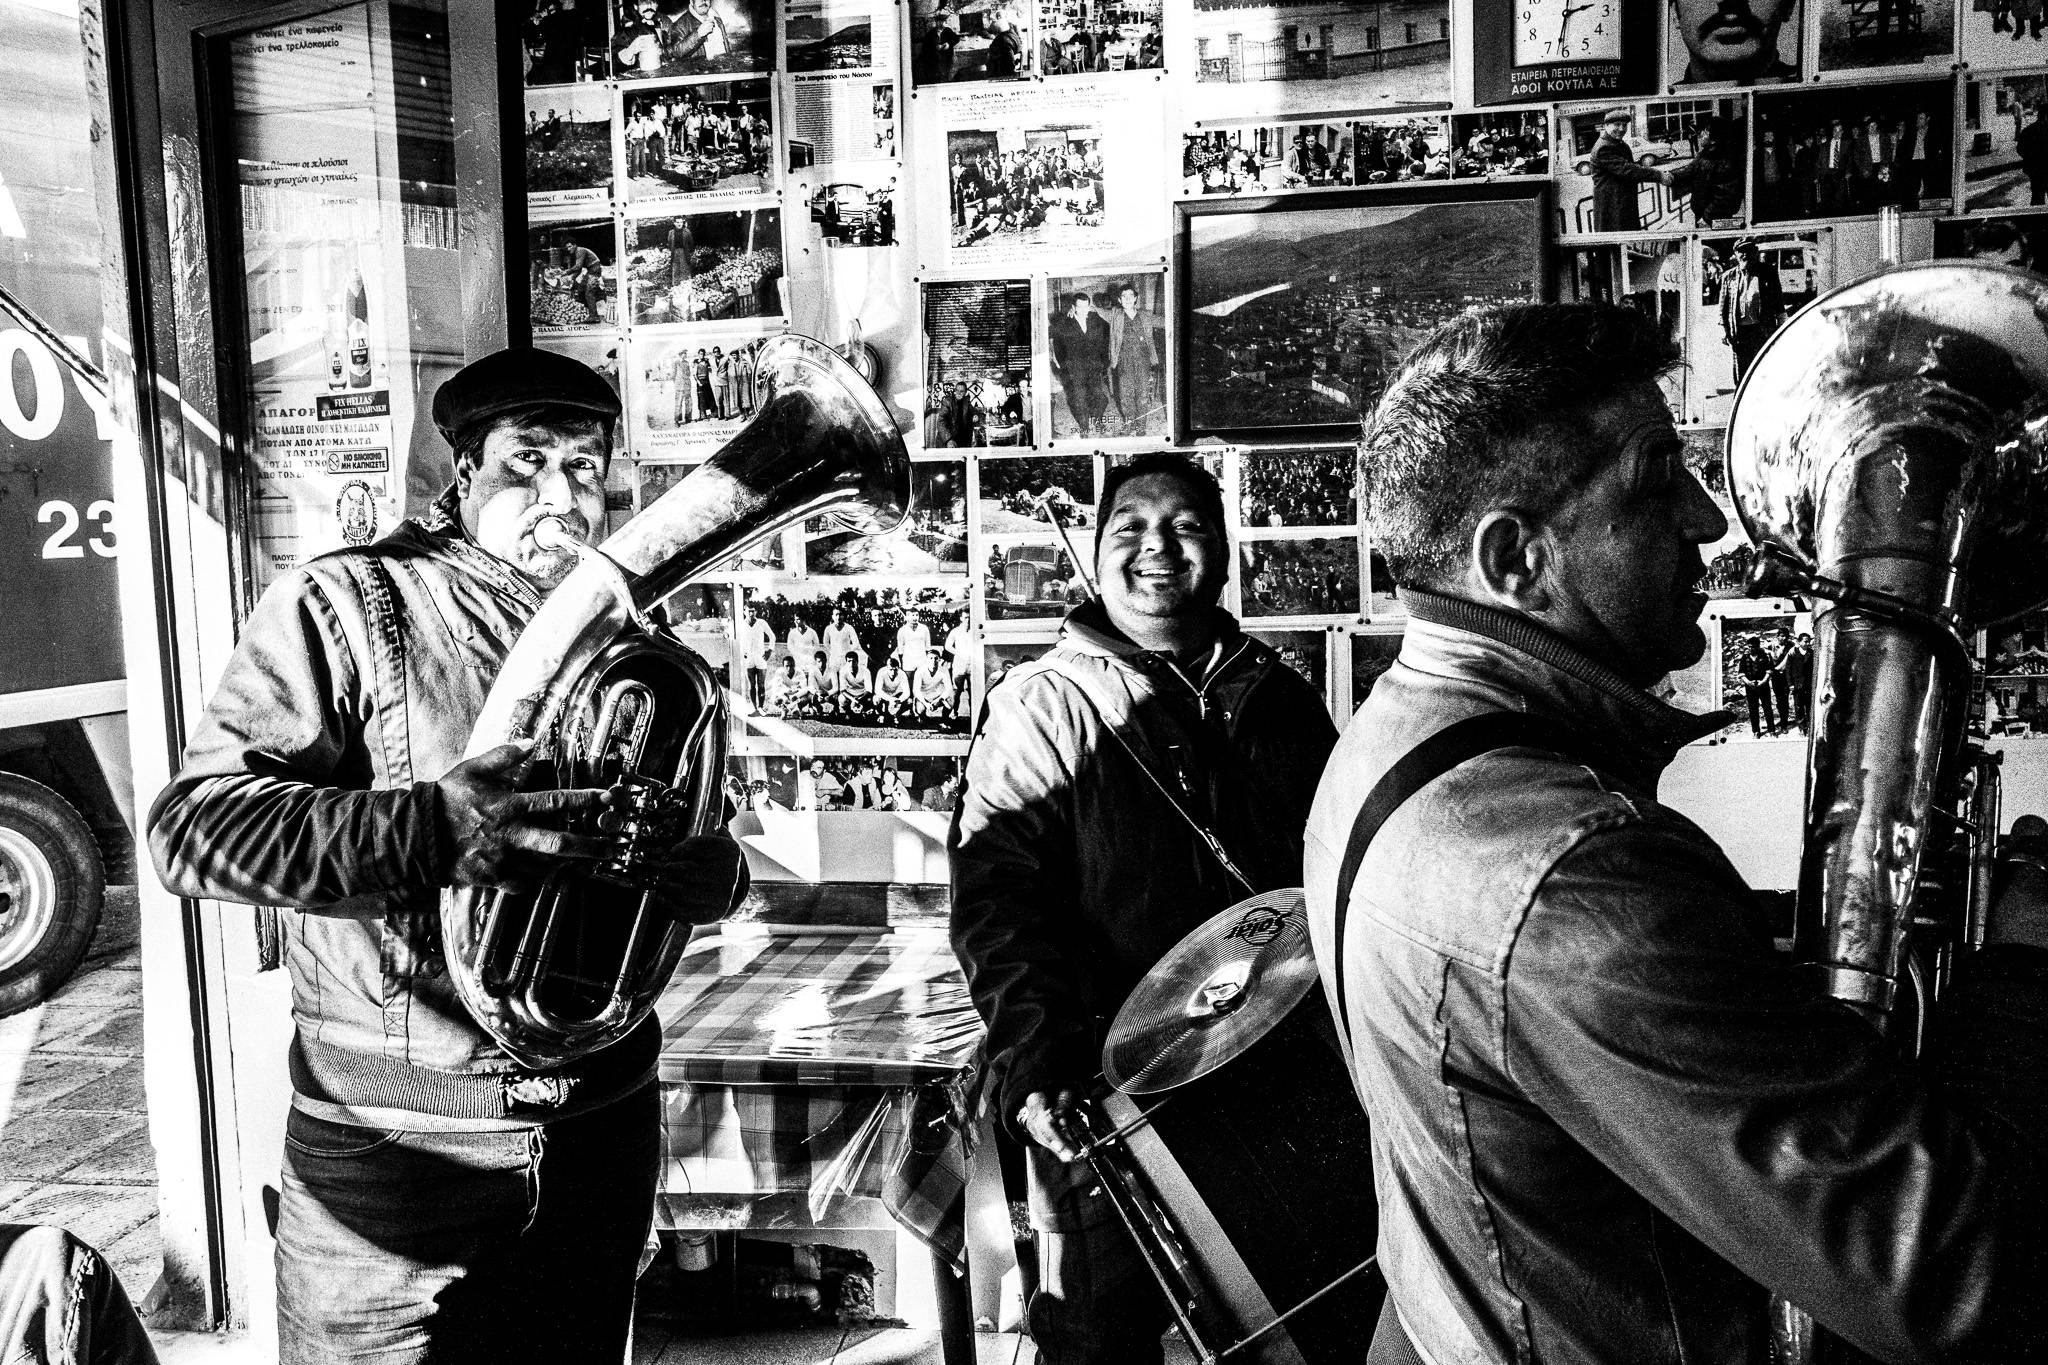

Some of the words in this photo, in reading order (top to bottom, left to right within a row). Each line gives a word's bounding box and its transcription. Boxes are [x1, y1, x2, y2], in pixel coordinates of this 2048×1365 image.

[1601, 4, 1610, 17] 3
[1522, 11, 1531, 23] 9
[1529, 28, 1537, 40] 8
[1594, 23, 1604, 35] 4
[1544, 41, 1552, 54] 7
[1581, 38, 1589, 51] 5
[1561, 45, 1570, 58] 6
[1511, 69, 1548, 83] ΕΤΑΙΡΕΙΑ
[1511, 82, 1541, 96] ΑΦΟΙ
[1547, 78, 1594, 92] ΚΟΥΤΛΑ
[334, 397, 346, 407] FIX
[346, 395, 373, 406] HELLAS
[259, 407, 316, 418] ΑΠΑΓΟΡ
[294, 438, 313, 447] ΑΠΟ
[315, 438, 345, 447] ΑΤΟΜΑ
[309, 449, 318, 457] 17
[344, 453, 353, 462] NO
[353, 452, 382, 461] SMOKING
[341, 462, 352, 470] ΜΗ
[352, 460, 386, 470] ΚΑΠΝΙΖΕΤΕ
[1223, 911, 1293, 941] Solar
